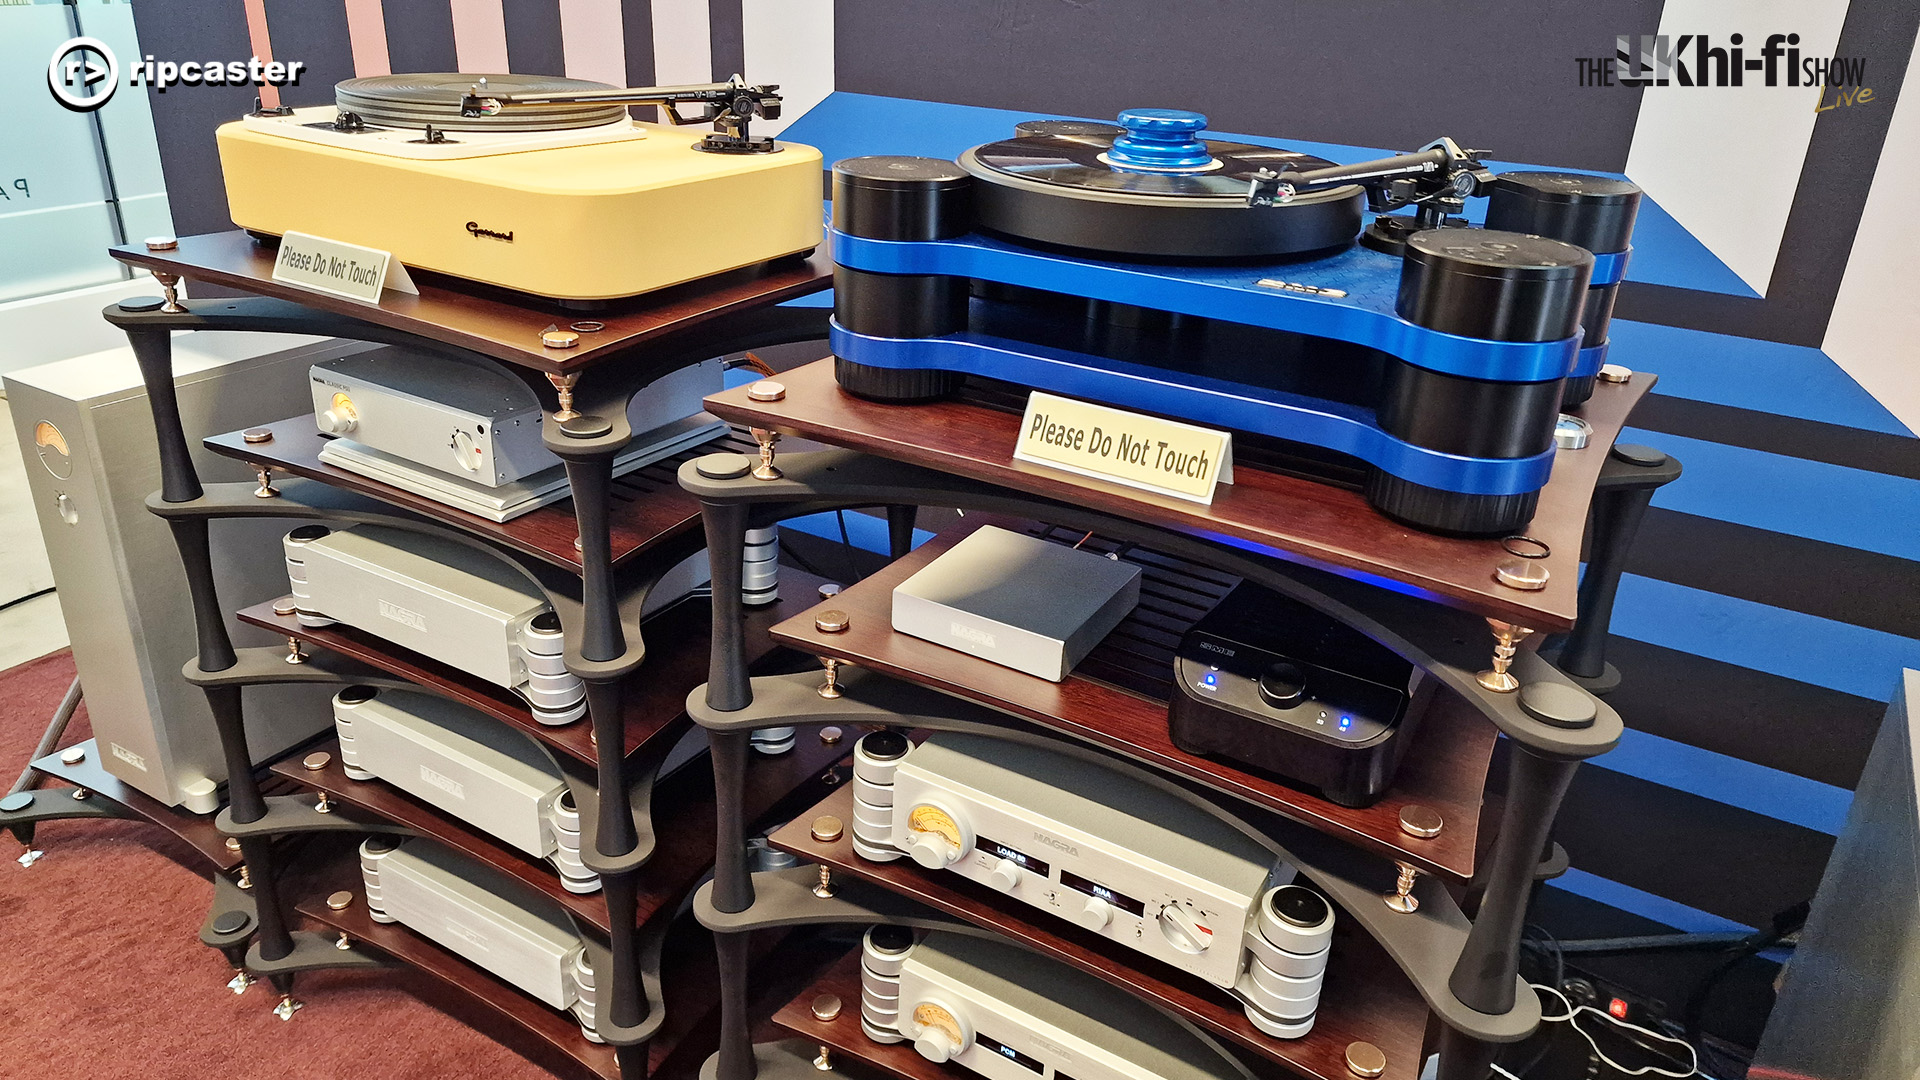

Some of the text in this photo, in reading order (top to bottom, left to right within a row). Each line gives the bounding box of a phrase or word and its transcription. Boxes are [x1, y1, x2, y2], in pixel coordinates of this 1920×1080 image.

[281, 245, 378, 287] Please Do Not Touch
[1029, 413, 1209, 480] Please Do Not Touch
[1196, 681, 1218, 693] POWER
[1033, 831, 1080, 858] NAGRA
[996, 845, 1017, 860] LOAD
[1092, 885, 1112, 899] RIAA
[1000, 1045, 1016, 1058] PCM
